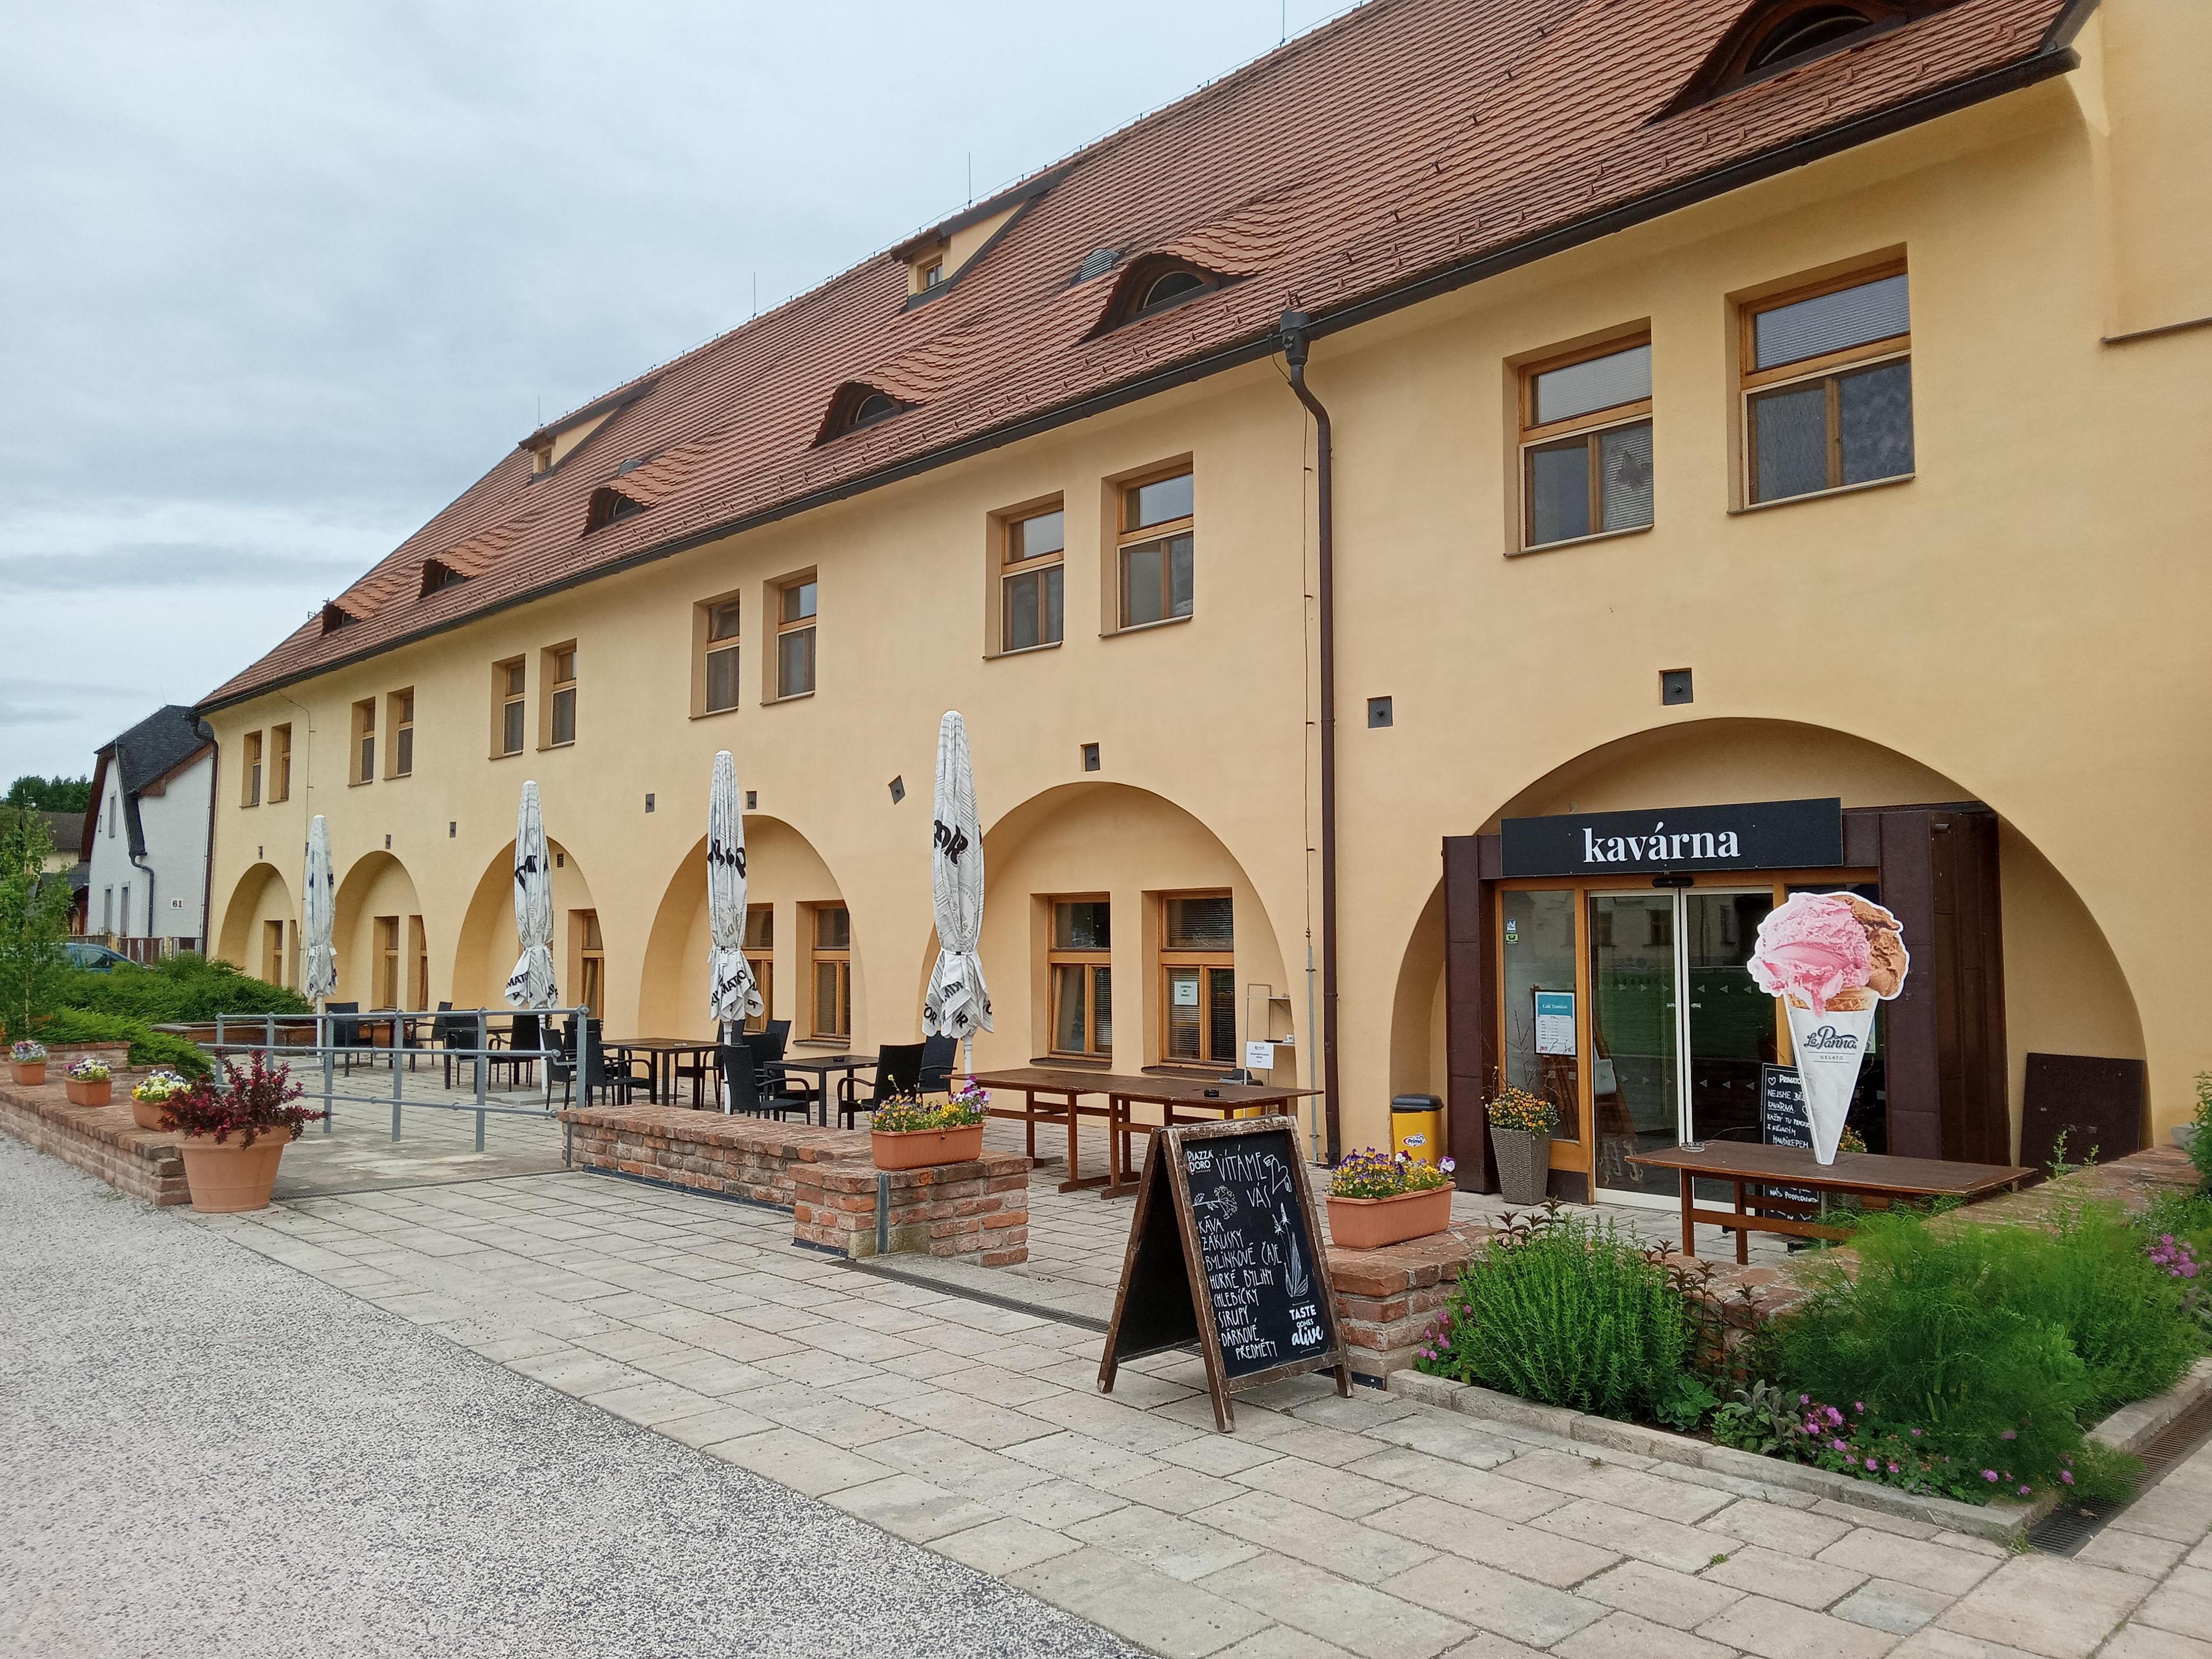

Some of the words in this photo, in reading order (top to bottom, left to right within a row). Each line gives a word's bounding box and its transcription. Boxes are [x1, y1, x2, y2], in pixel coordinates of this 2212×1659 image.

[1582, 821, 1741, 863] kavárna
[1817, 1025, 1858, 1050] Panna
[1779, 1074, 1802, 1084] PRIMATO
[1187, 1150, 1214, 1161] PIAZZA
[1216, 1144, 1267, 1182] VÍTÁME
[1246, 1182, 1271, 1208] VÁS
[1198, 1215, 1225, 1234] KÁVA
[1202, 1229, 1244, 1251] ZÁKUSKY
[1261, 1241, 1282, 1266] ČAJE
[1209, 1269, 1239, 1290] HORKÉ
[1214, 1288, 1259, 1307] CHLEBÍČKY
[1289, 1305, 1317, 1321] TASTE
[1221, 1317, 1260, 1347] DÁRKOVÉ
[1291, 1325, 1323, 1346] alive
[1235, 1338, 1278, 1360] PŘEDMĚTY
